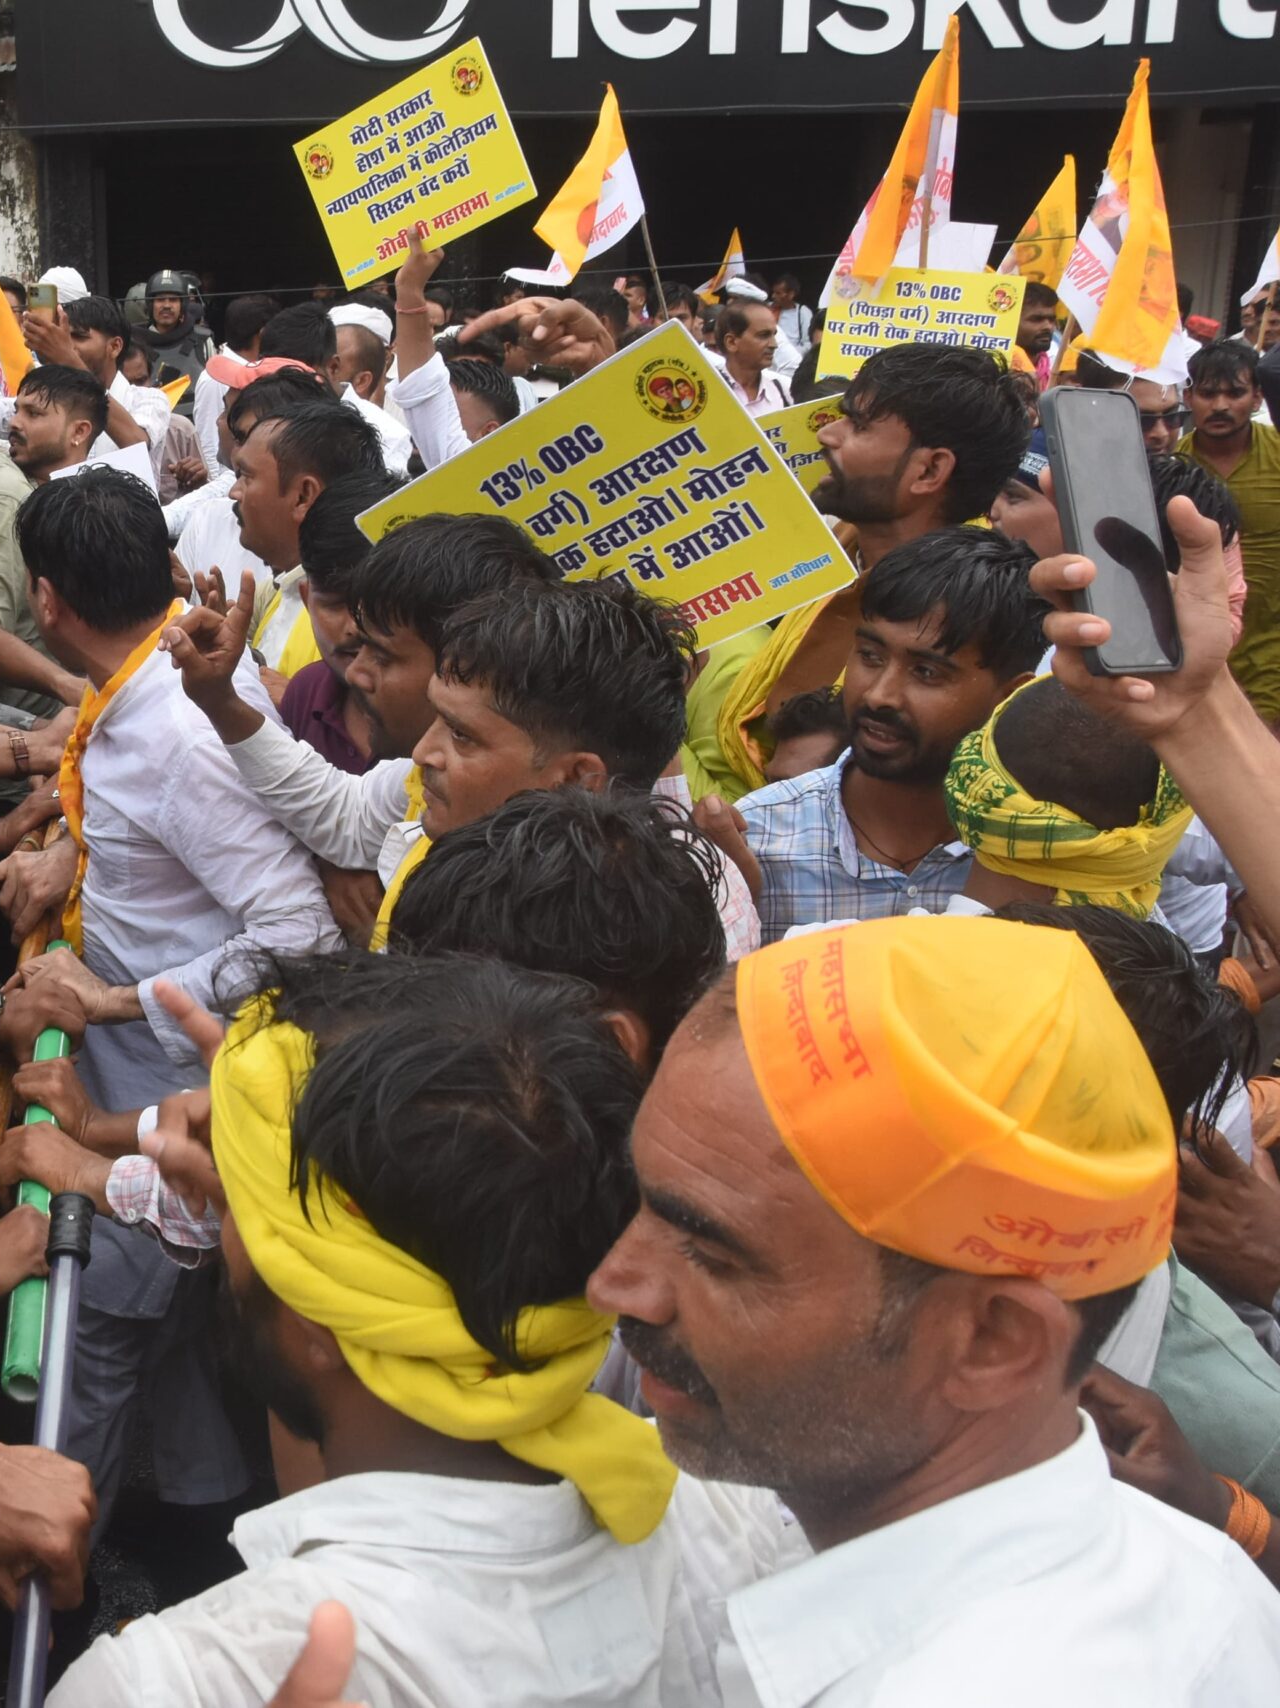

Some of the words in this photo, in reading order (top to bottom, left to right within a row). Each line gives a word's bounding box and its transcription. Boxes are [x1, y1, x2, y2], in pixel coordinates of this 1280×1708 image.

[349, 116, 384, 147] मोदी
[386, 89, 434, 127] सरकार
[355, 147, 386, 174] होश
[387, 132, 401, 155] में
[403, 111, 447, 148] आओ
[325, 164, 407, 217] न्यायपालिका
[410, 150, 422, 172] में
[424, 113, 498, 165] कोलेजियम
[367, 189, 416, 224] सिस्टम
[418, 175, 441, 197] बंद
[442, 154, 471, 184] करों
[433, 191, 491, 230] महासभा
[849, 301, 895, 321] (पिछड़ा
[935, 310, 996, 329] आरक्षण
[896, 281, 926, 299] 13%
[930, 285, 962, 302] OBC
[827, 320, 844, 335] पर
[849, 320, 880, 338] लगी
[884, 322, 910, 341] रोक
[970, 331, 1011, 351] मोहन
[840, 343, 883, 357] सरका
[479, 457, 547, 508] 13%
[538, 423, 604, 475] OBC
[588, 426, 708, 506] आरक्षण
[682, 446, 771, 502] मोहन
[628, 546, 665, 581] में
[675, 571, 764, 628] हासभा
[769, 575, 790, 589] जय
[790, 553, 833, 580] संविधान
